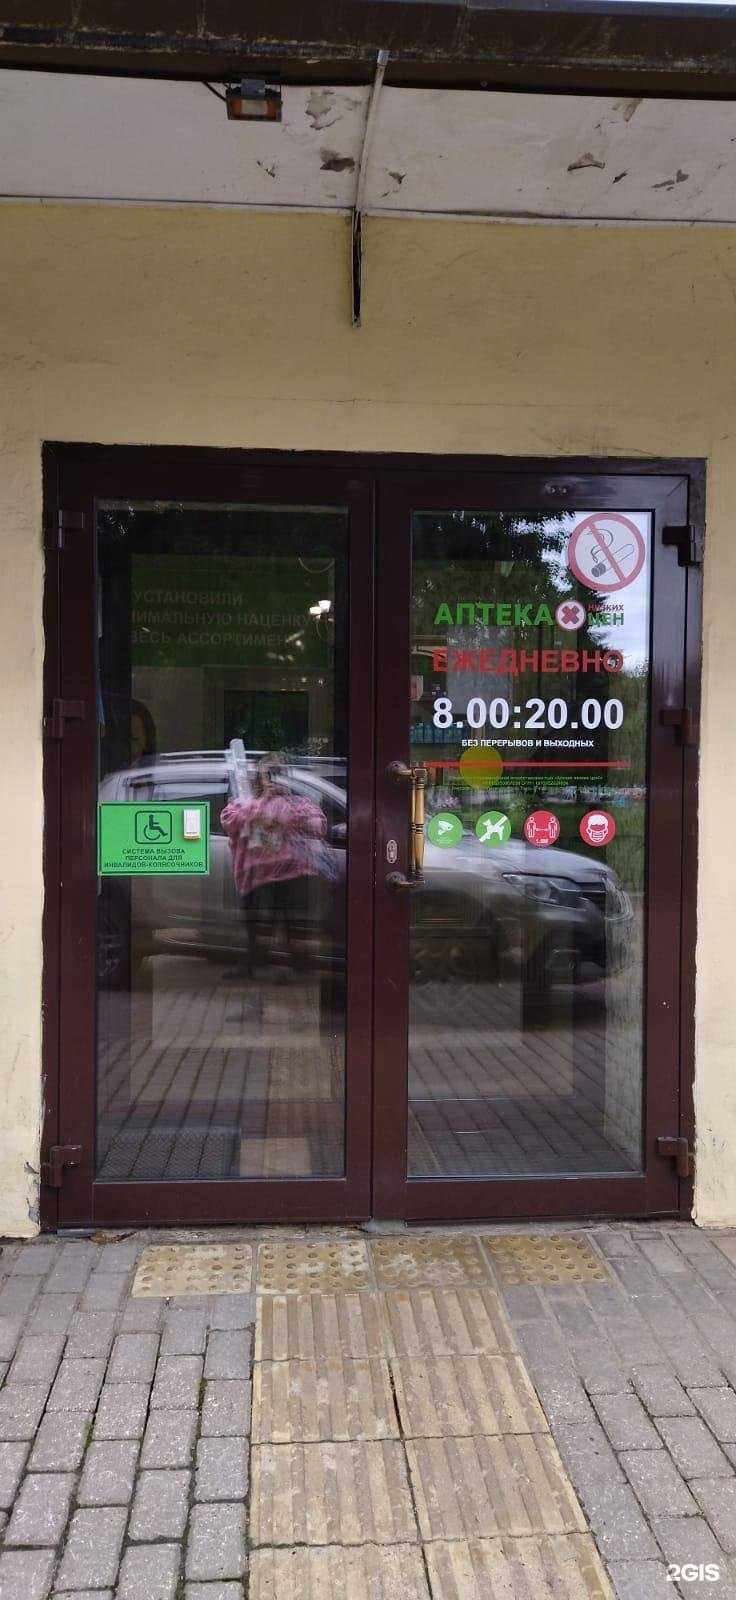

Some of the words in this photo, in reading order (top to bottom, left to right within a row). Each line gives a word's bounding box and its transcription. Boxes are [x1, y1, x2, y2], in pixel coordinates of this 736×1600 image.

[133, 591, 243, 605] УСТАНОВИЛИ
[434, 603, 553, 625] АПТЕКА
[176, 632, 297, 647] АССОРТИМЕН
[433, 648, 624, 676] ЕЖЕДНЕВНО
[433, 697, 624, 729] 8.00:20.00
[462, 739, 479, 748] БЕЗ
[480, 739, 533, 748] ПЕРЕРЫВОВ
[536, 740, 542, 748] И
[544, 739, 594, 748] ВЫХОДНЫХ
